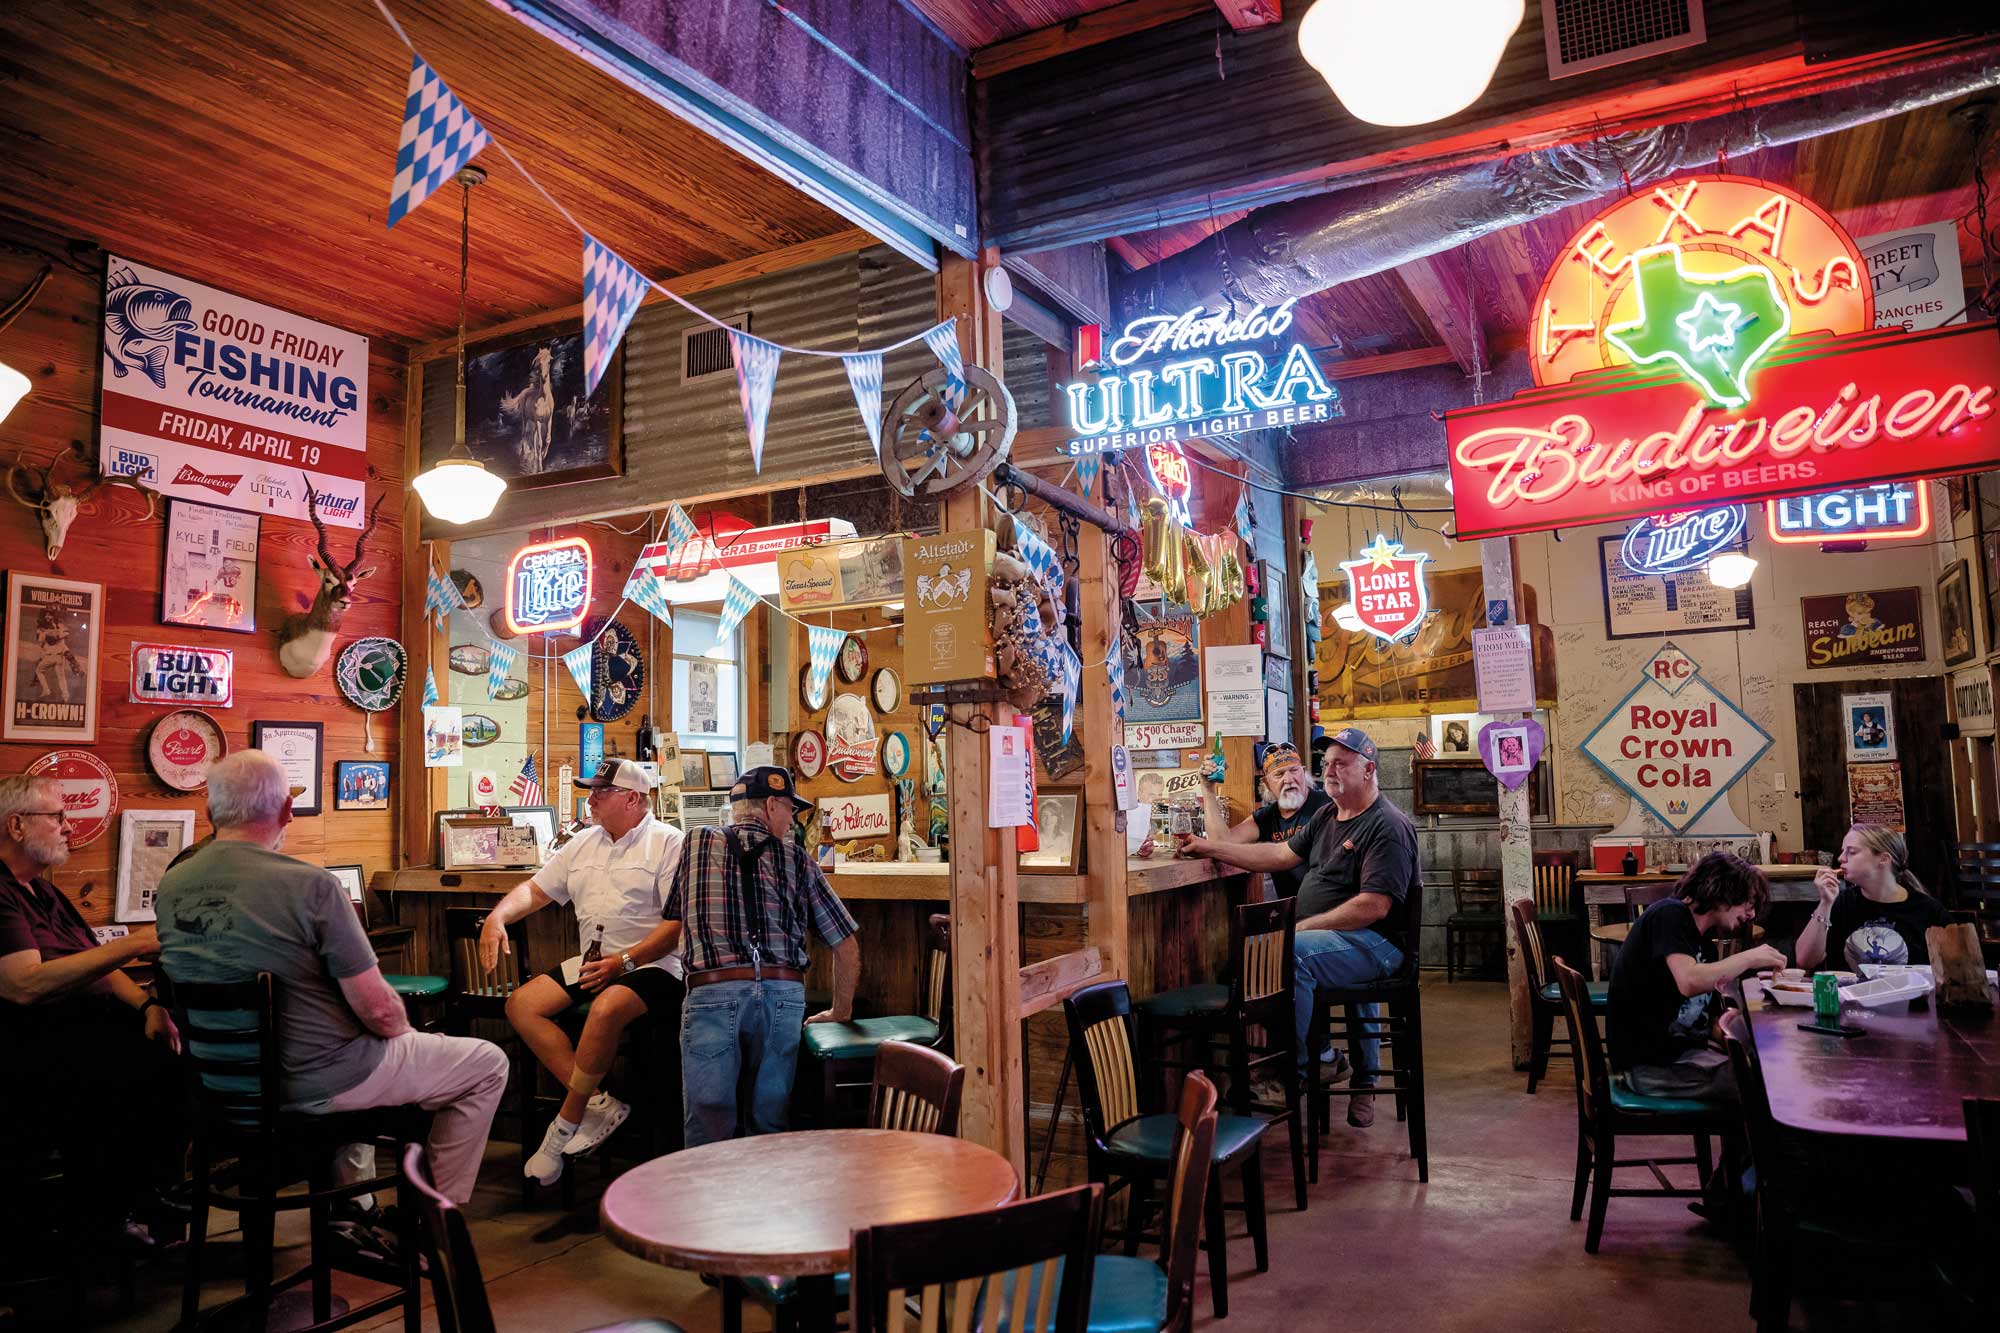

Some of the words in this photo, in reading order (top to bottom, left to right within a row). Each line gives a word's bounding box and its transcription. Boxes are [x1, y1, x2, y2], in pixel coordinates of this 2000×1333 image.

[1543, 181, 1859, 356] TEXAS
[1870, 265, 1906, 291] TY
[202, 309, 265, 345] GOOD
[270, 330, 344, 368] FRIDAY
[1111, 297, 1297, 365] Michelob
[174, 329, 357, 411] FISHING
[186, 366, 348, 428] Tournament
[1067, 344, 1332, 434] ULTRA
[158, 411, 234, 450] FRIDAY,
[239, 431, 293, 460] APRIL
[300, 444, 321, 465] 19
[1070, 426, 1176, 455] SUPERIOR
[1189, 414, 1253, 436] LIGHT
[1266, 404, 1329, 425] BEER
[1456, 382, 1993, 504] Budweiser
[118, 451, 150, 468] BUD
[112, 460, 155, 480] LIGHT
[178, 467, 236, 489] Budweiser
[250, 482, 292, 500] ULTRA
[1609, 481, 1675, 504] KING
[1680, 475, 1718, 494] OF
[1723, 461, 1817, 490] BEERS
[302, 489, 359, 511] Natural
[1779, 491, 1914, 529] LIGHT
[323, 506, 354, 519] LIGHT
[176, 531, 205, 545] KYLE
[226, 539, 255, 553] FIELD
[720, 543, 757, 557] GRAB
[758, 541, 783, 551] SOME
[784, 534, 822, 548] BUDS
[1645, 507, 1729, 568] Lite
[786, 579, 806, 591] Texas
[807, 578, 832, 591] Special
[1359, 572, 1410, 592] LONE
[31, 590, 55, 602] WORLD
[60, 594, 83, 606] SERIES
[516, 570, 586, 624] Lite
[1361, 592, 1413, 611] STAR
[1808, 619, 1839, 629] REACH
[1484, 631, 1517, 642] HIDING
[1811, 622, 1916, 665] Sunbeam
[1478, 642, 1503, 653] FROM
[156, 653, 213, 674] BUD
[1430, 653, 1465, 670] BEER
[1654, 659, 1689, 679] RC
[143, 673, 223, 694] LIGHT
[1222, 693, 1249, 701] WARNING
[1358, 691, 1391, 704] AND
[16, 702, 85, 721] H-CROWN!
[1630, 702, 1717, 735] Royal
[274, 729, 315, 742] Appreciation
[1162, 722, 1197, 736] Charge
[165, 740, 203, 756] Pearl
[1158, 737, 1168, 745] for
[1170, 735, 1202, 745] Whining
[1620, 735, 1733, 759] Crown
[1637, 763, 1712, 788] Cola
[61, 787, 101, 807] earl
